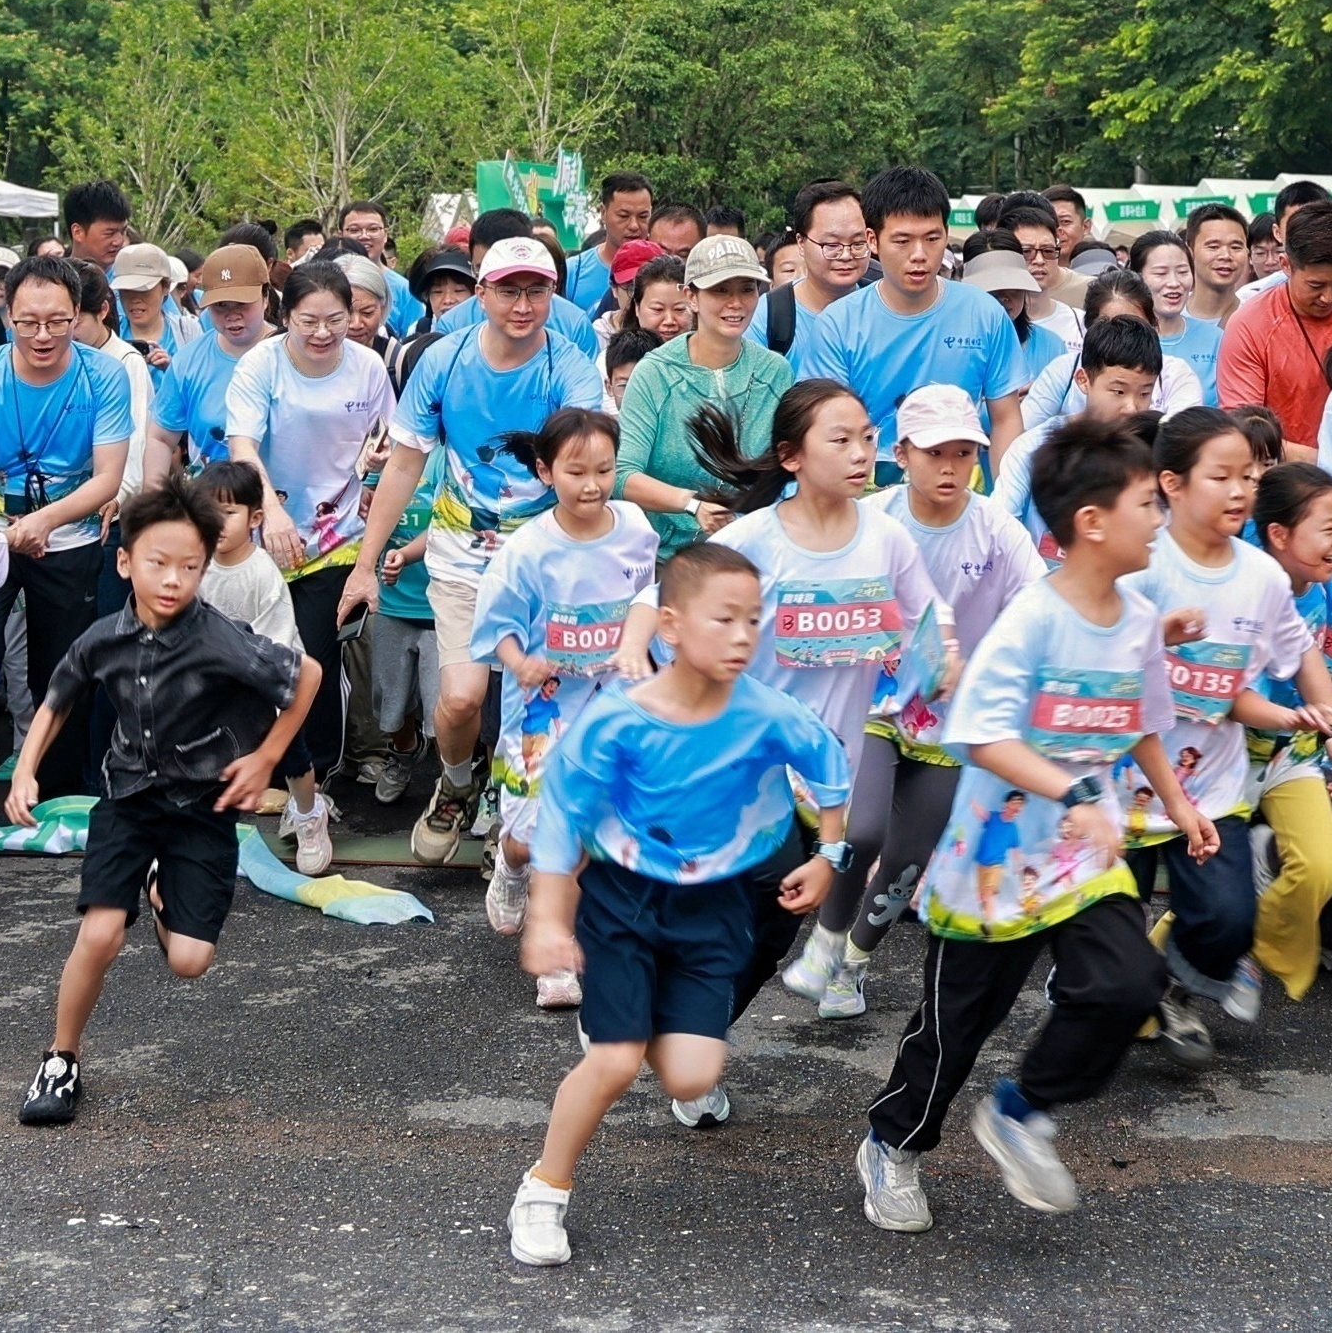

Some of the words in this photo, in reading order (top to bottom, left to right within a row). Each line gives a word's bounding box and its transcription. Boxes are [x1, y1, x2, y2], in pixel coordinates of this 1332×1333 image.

[797, 608, 883, 634] B0053
[563, 626, 622, 649] B007
[1050, 703, 1133, 729] B0025
